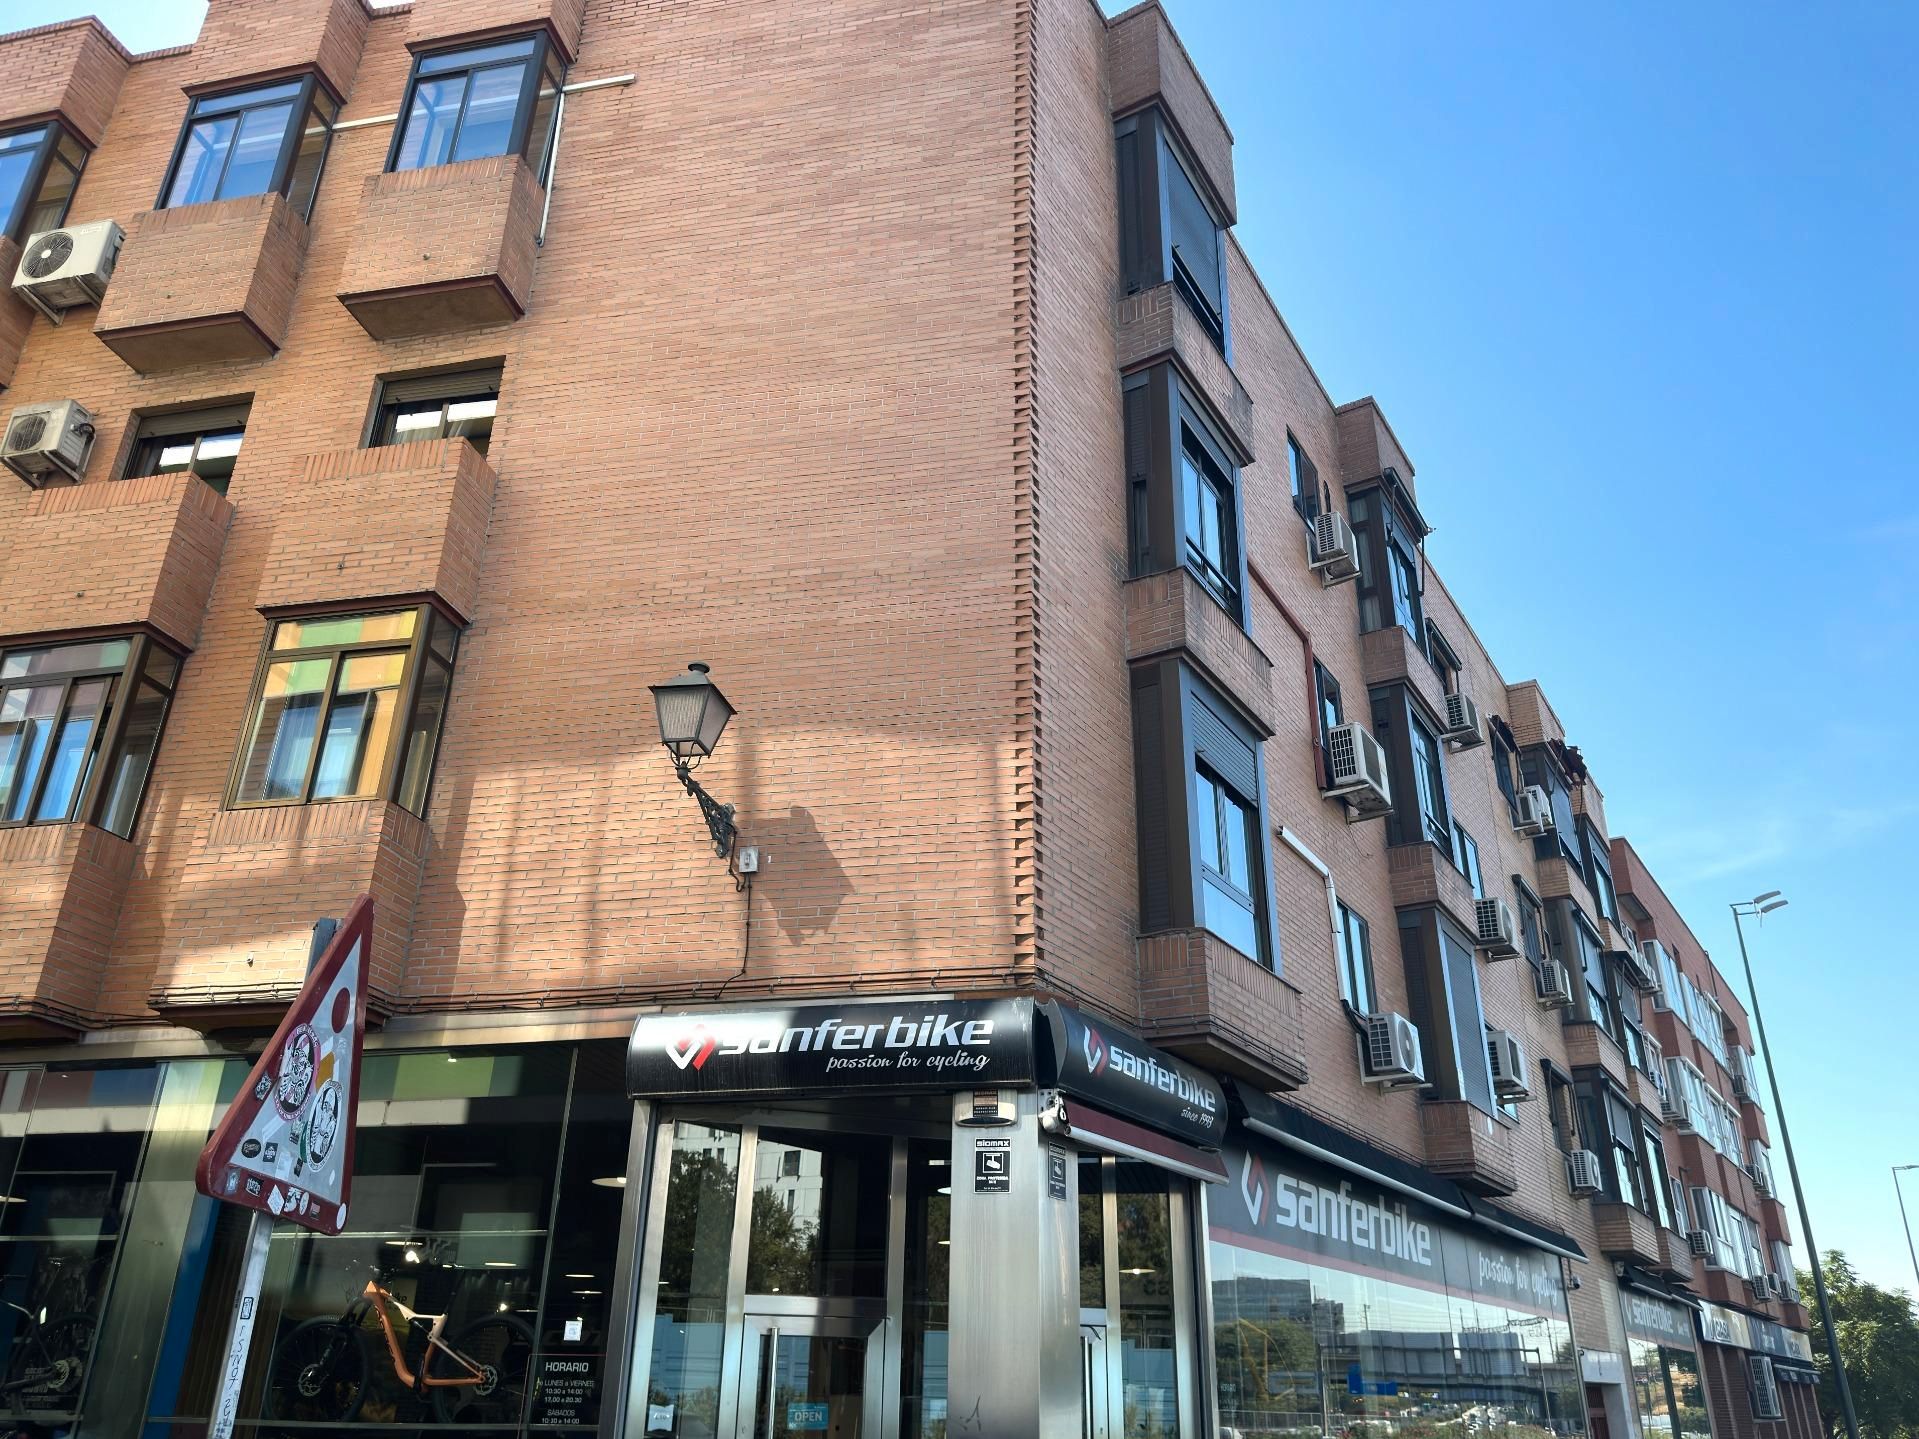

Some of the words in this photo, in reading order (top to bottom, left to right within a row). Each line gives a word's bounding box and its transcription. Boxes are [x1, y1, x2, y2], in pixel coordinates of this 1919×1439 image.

[718, 1014, 995, 1056] sanferbike
[826, 1054, 893, 1073] passion
[897, 1051, 920, 1069] for
[926, 1050, 991, 1072] cycling
[1109, 1045, 1216, 1113] sanferbike
[1180, 1106, 1199, 1122] since
[1275, 1173, 1432, 1266] sanferbike
[1478, 1251, 1515, 1288] passion
[1516, 1255, 1528, 1291] for
[545, 1361, 589, 1372] HORARIO
[794, 1411, 823, 1421] OPEN
